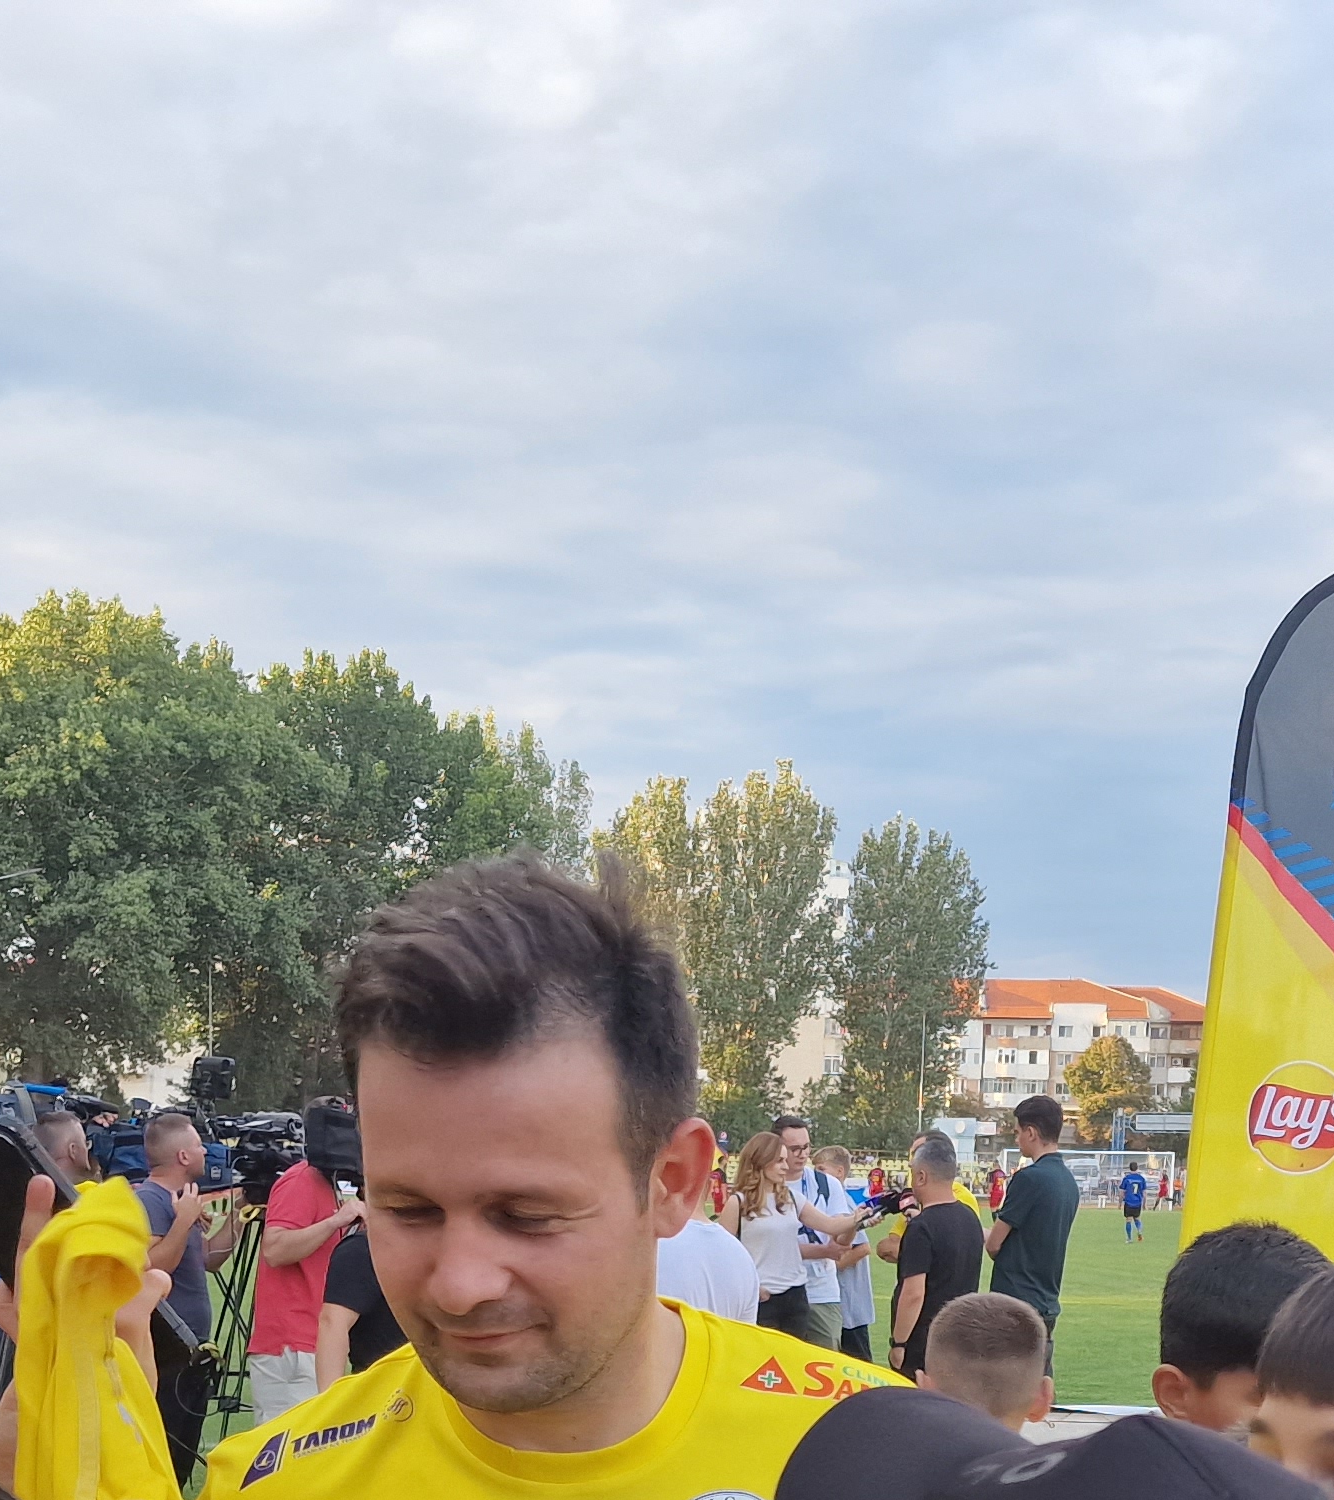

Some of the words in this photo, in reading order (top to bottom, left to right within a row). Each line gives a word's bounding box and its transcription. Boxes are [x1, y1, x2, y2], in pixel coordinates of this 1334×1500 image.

[803, 1361, 870, 1400] SA
[842, 1366, 892, 1387] CLIN
[291, 1413, 377, 1454] TAROM
